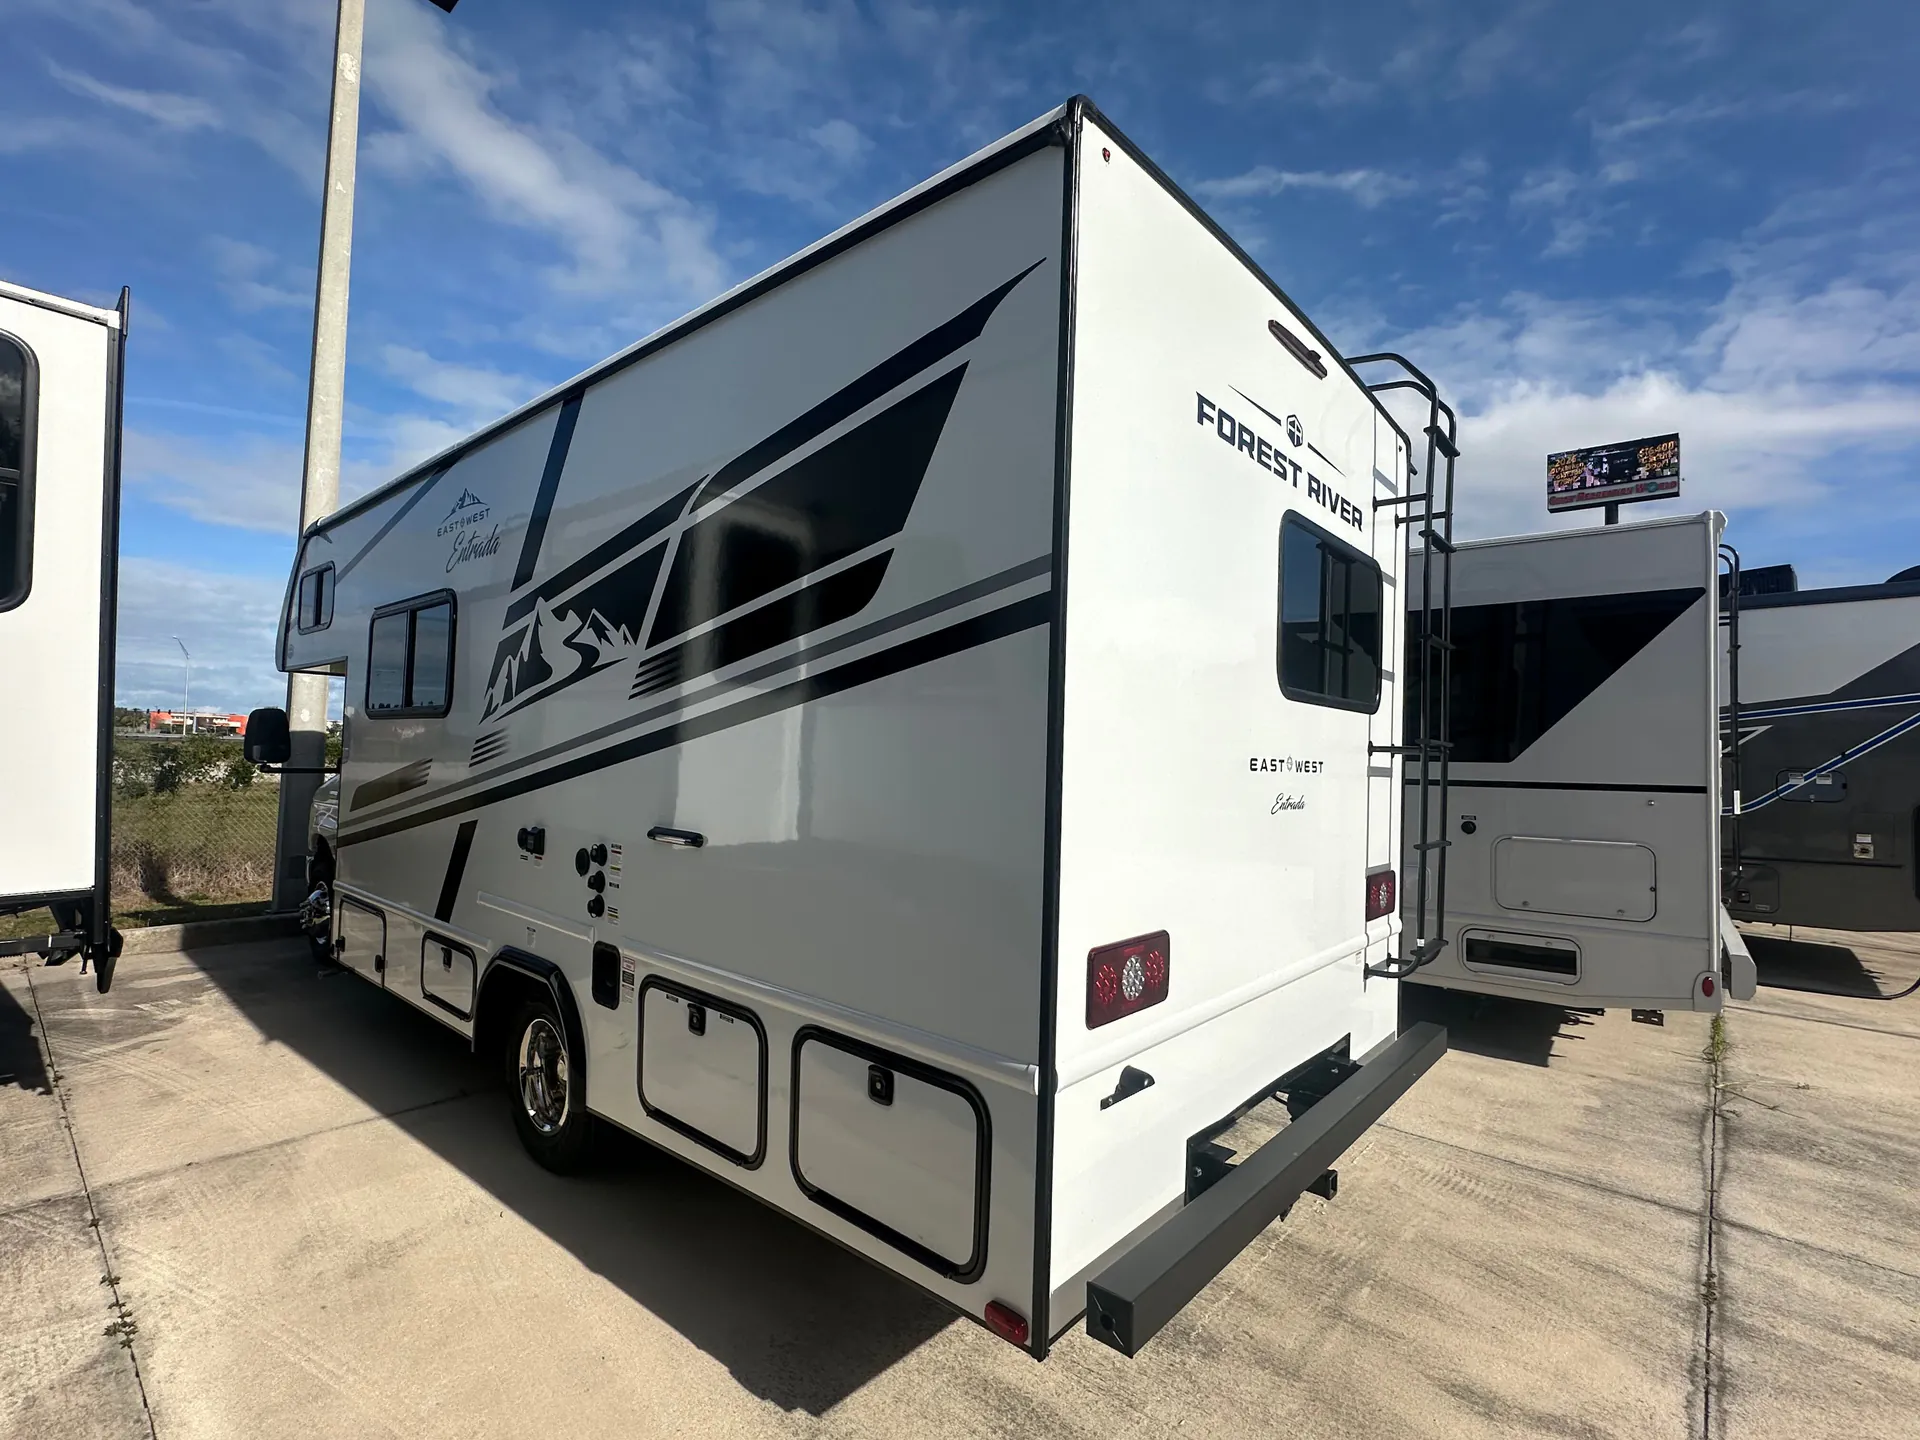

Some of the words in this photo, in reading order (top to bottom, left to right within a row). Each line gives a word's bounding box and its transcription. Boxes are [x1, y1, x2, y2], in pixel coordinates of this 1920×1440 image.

[1196, 391, 1302, 488] FOREST
[1307, 472, 1362, 532] RIVER
[437, 520, 461, 537] EAST
[466, 508, 490, 526] WEST
[446, 524, 500, 573] Entrada
[1250, 758, 1285, 772] EAST
[1295, 760, 1323, 773] WEST
[1271, 793, 1305, 815] Entrada
